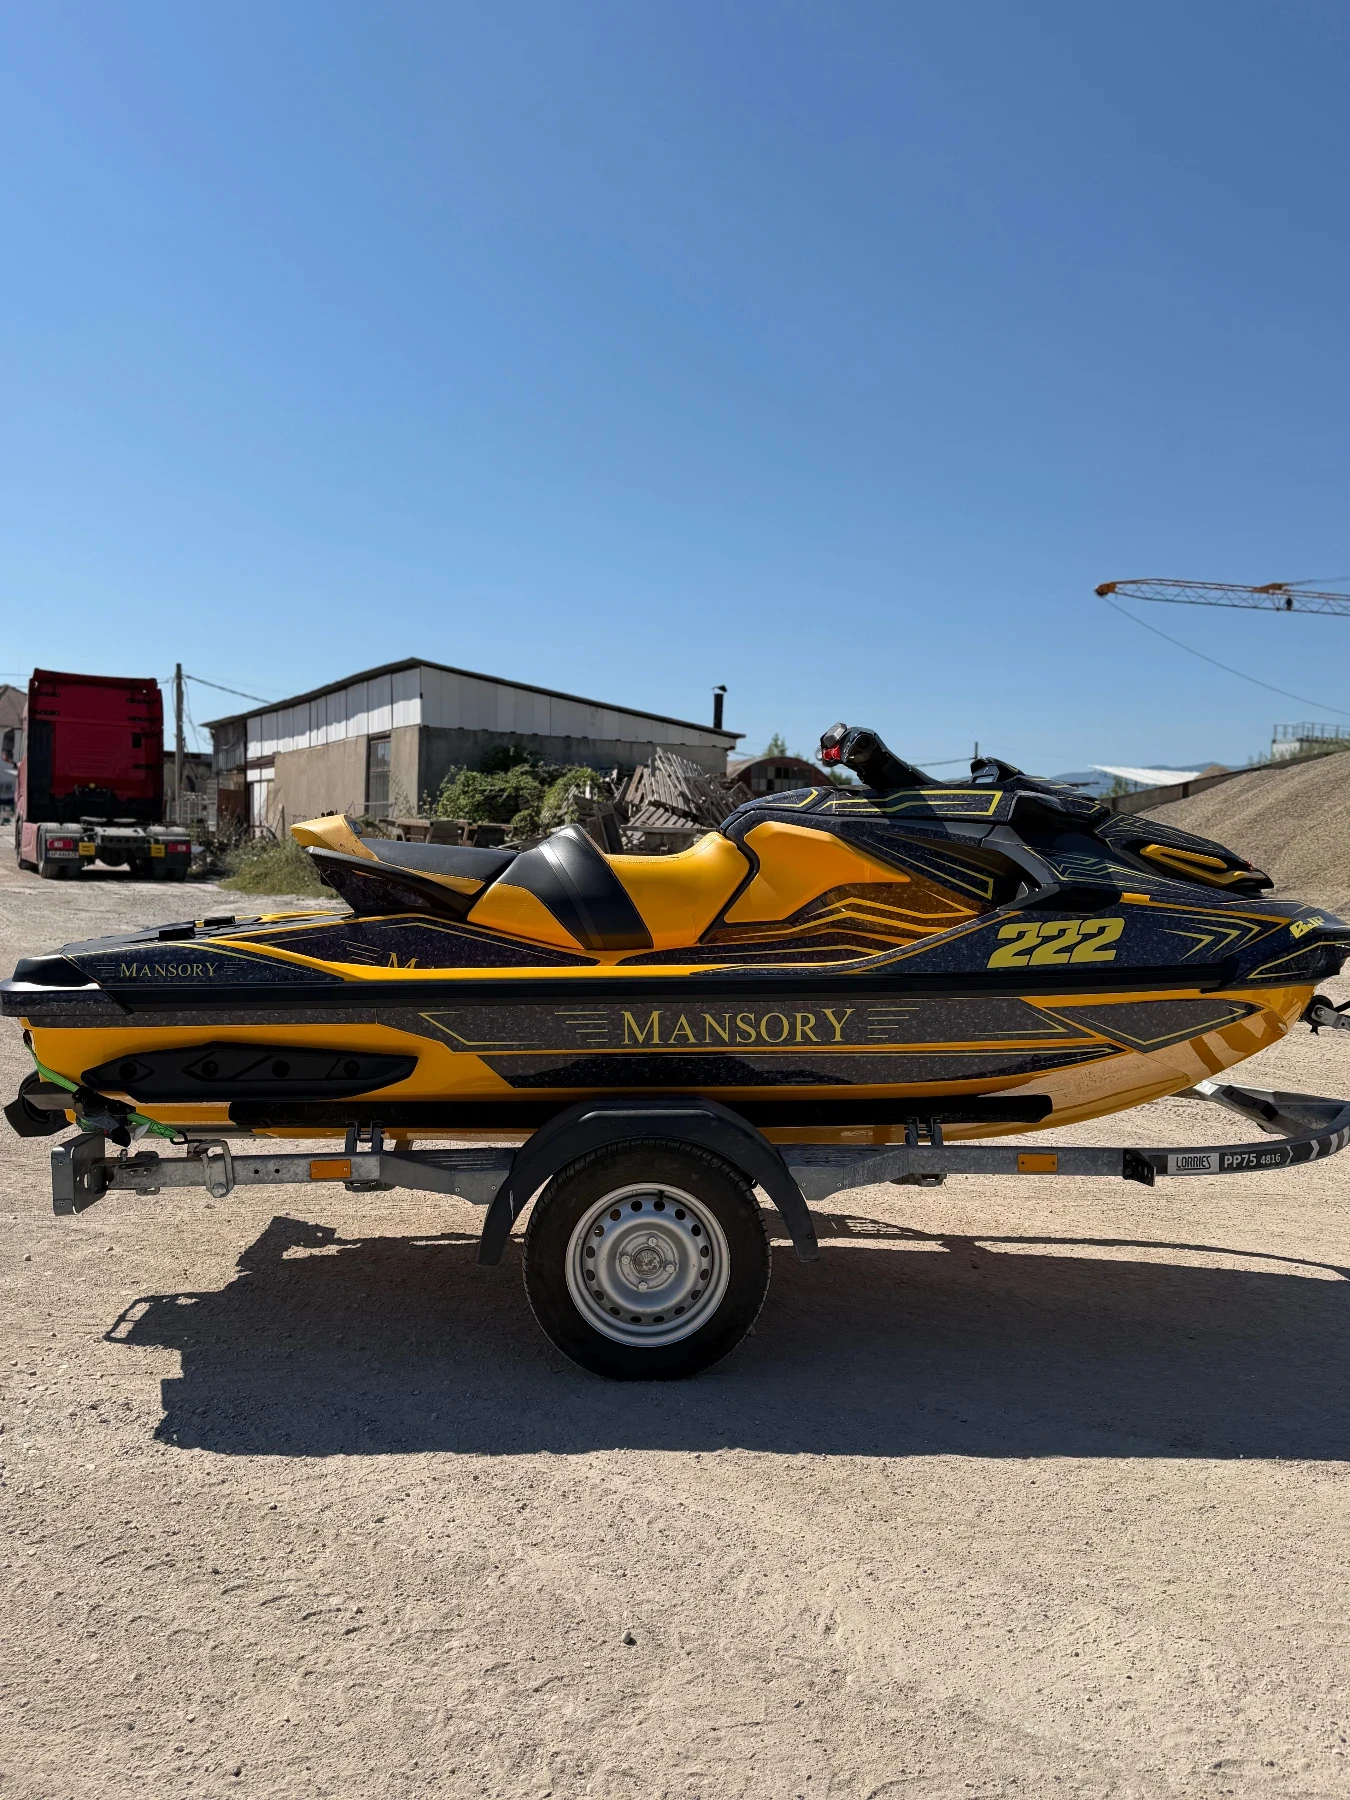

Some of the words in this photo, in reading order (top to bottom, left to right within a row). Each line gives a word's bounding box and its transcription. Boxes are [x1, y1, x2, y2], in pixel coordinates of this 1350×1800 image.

[987, 917, 1125, 968] 222
[120, 962, 219, 977] MANSORY
[620, 1008, 856, 1044] MANSORY
[1176, 1155, 1211, 1171] LORRIES
[1224, 1153, 1257, 1168] PP75
[1260, 1153, 1281, 1164] 4816
